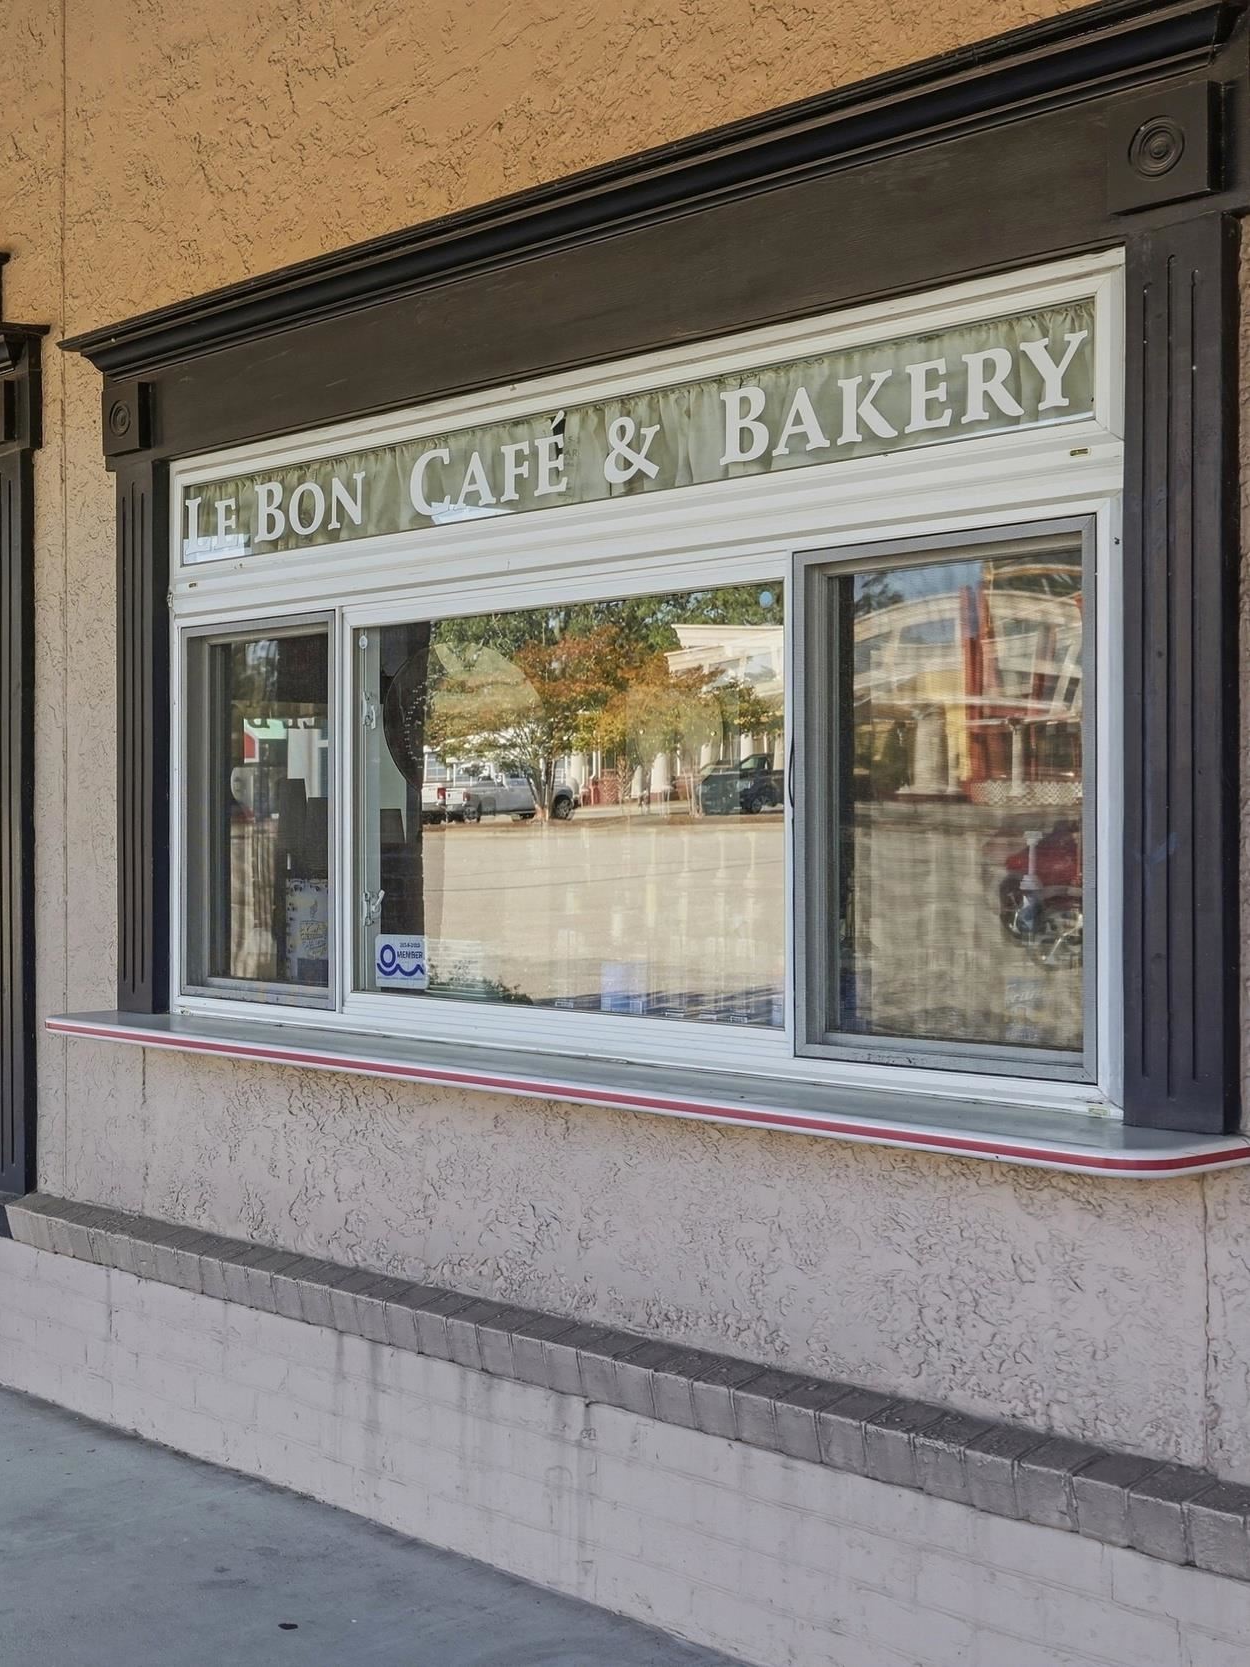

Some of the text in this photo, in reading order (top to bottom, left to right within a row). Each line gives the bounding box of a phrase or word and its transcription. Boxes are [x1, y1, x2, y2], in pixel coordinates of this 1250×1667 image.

[184, 496, 242, 556] LE
[253, 471, 366, 543] BON
[410, 411, 568, 516] CAFÉ
[603, 416, 660, 485] &
[719, 329, 1088, 466] BAKERY
[396, 950, 423, 959] MEMBER
